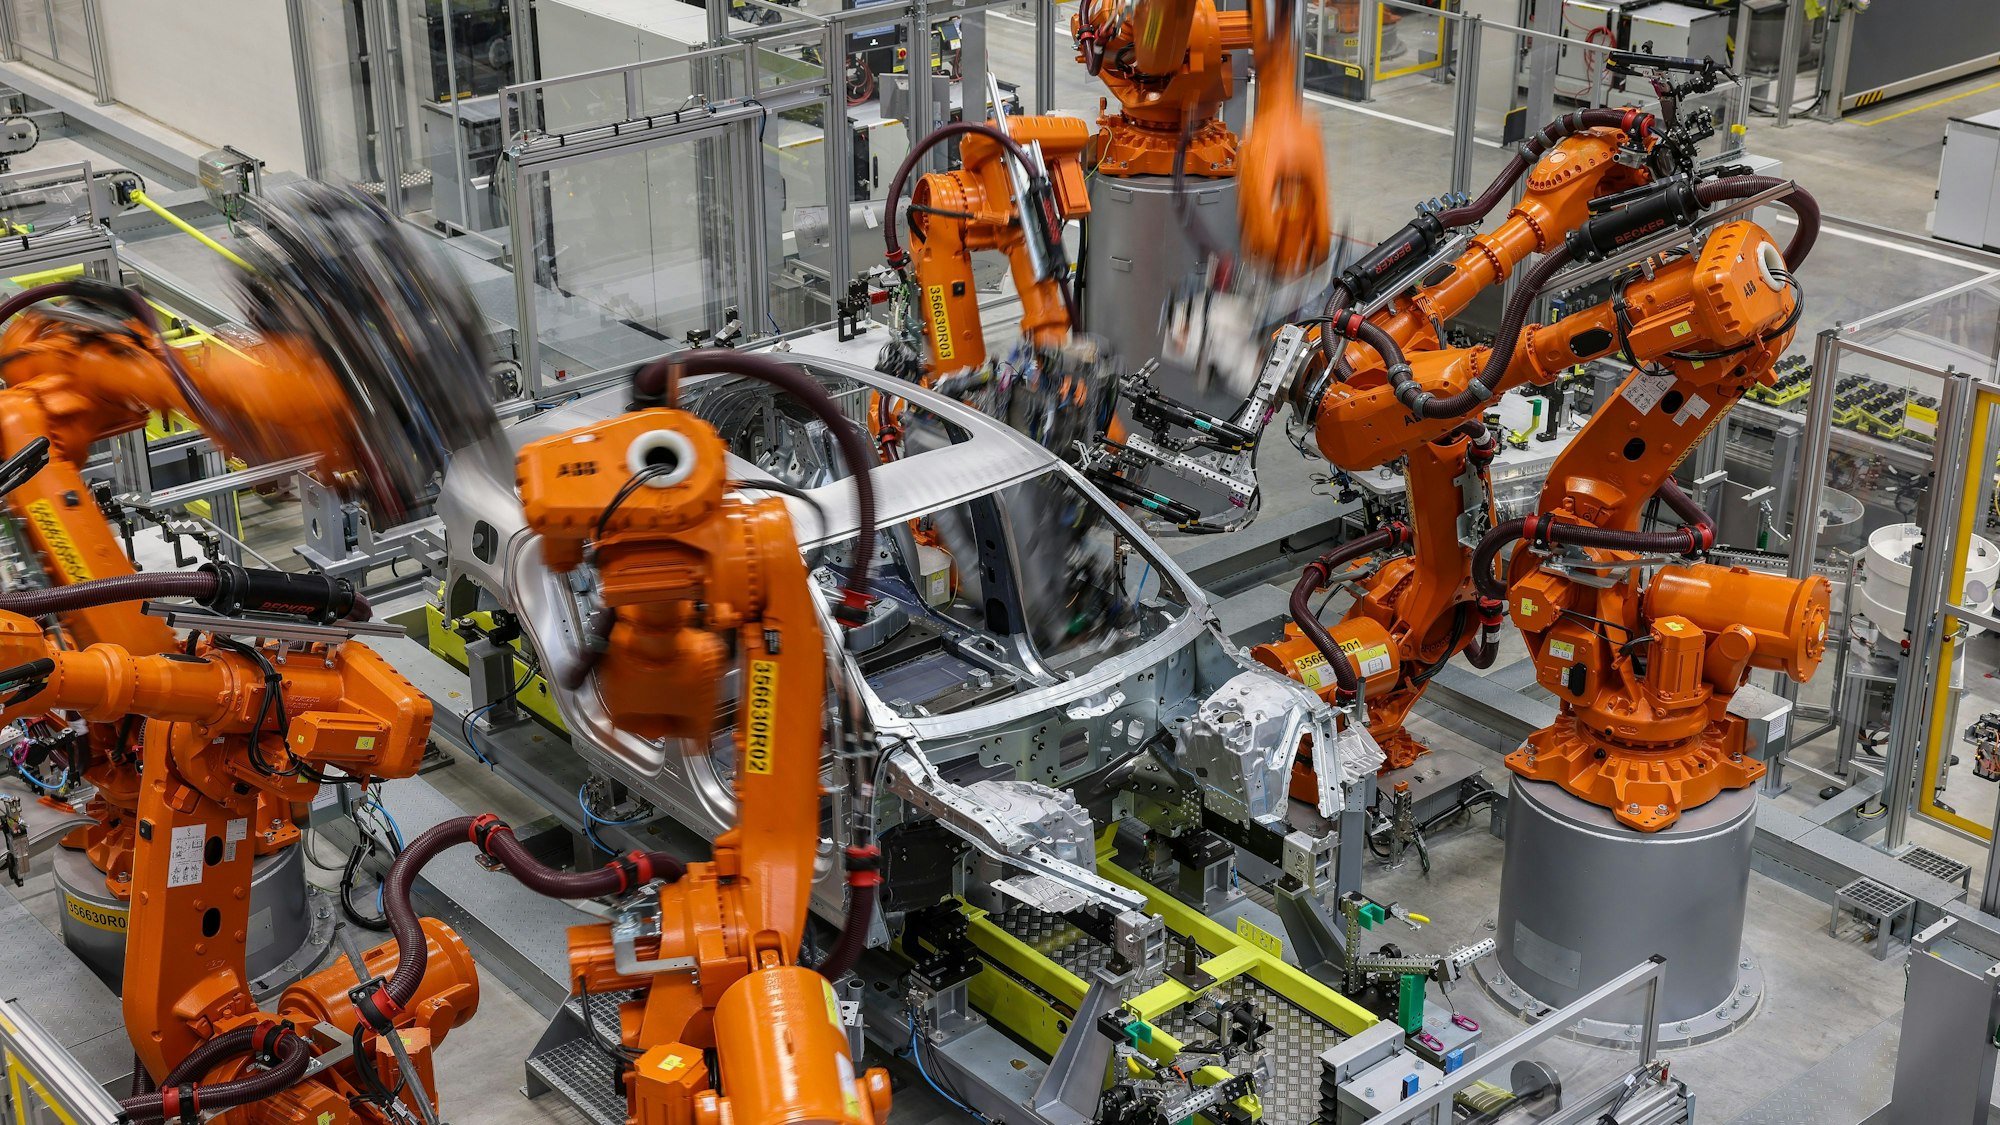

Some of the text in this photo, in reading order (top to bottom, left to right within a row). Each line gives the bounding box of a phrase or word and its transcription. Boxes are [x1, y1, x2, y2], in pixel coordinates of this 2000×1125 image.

[1615, 219, 1664, 245] BECKER
[1375, 242, 1412, 275] BECKER
[1743, 280, 1757, 299] ABB
[929, 287, 952, 359] 356630R03
[1297, 640, 1361, 670] 3566R01
[748, 663, 773, 772] 356630R02
[68, 900, 128, 928] 356630R0
